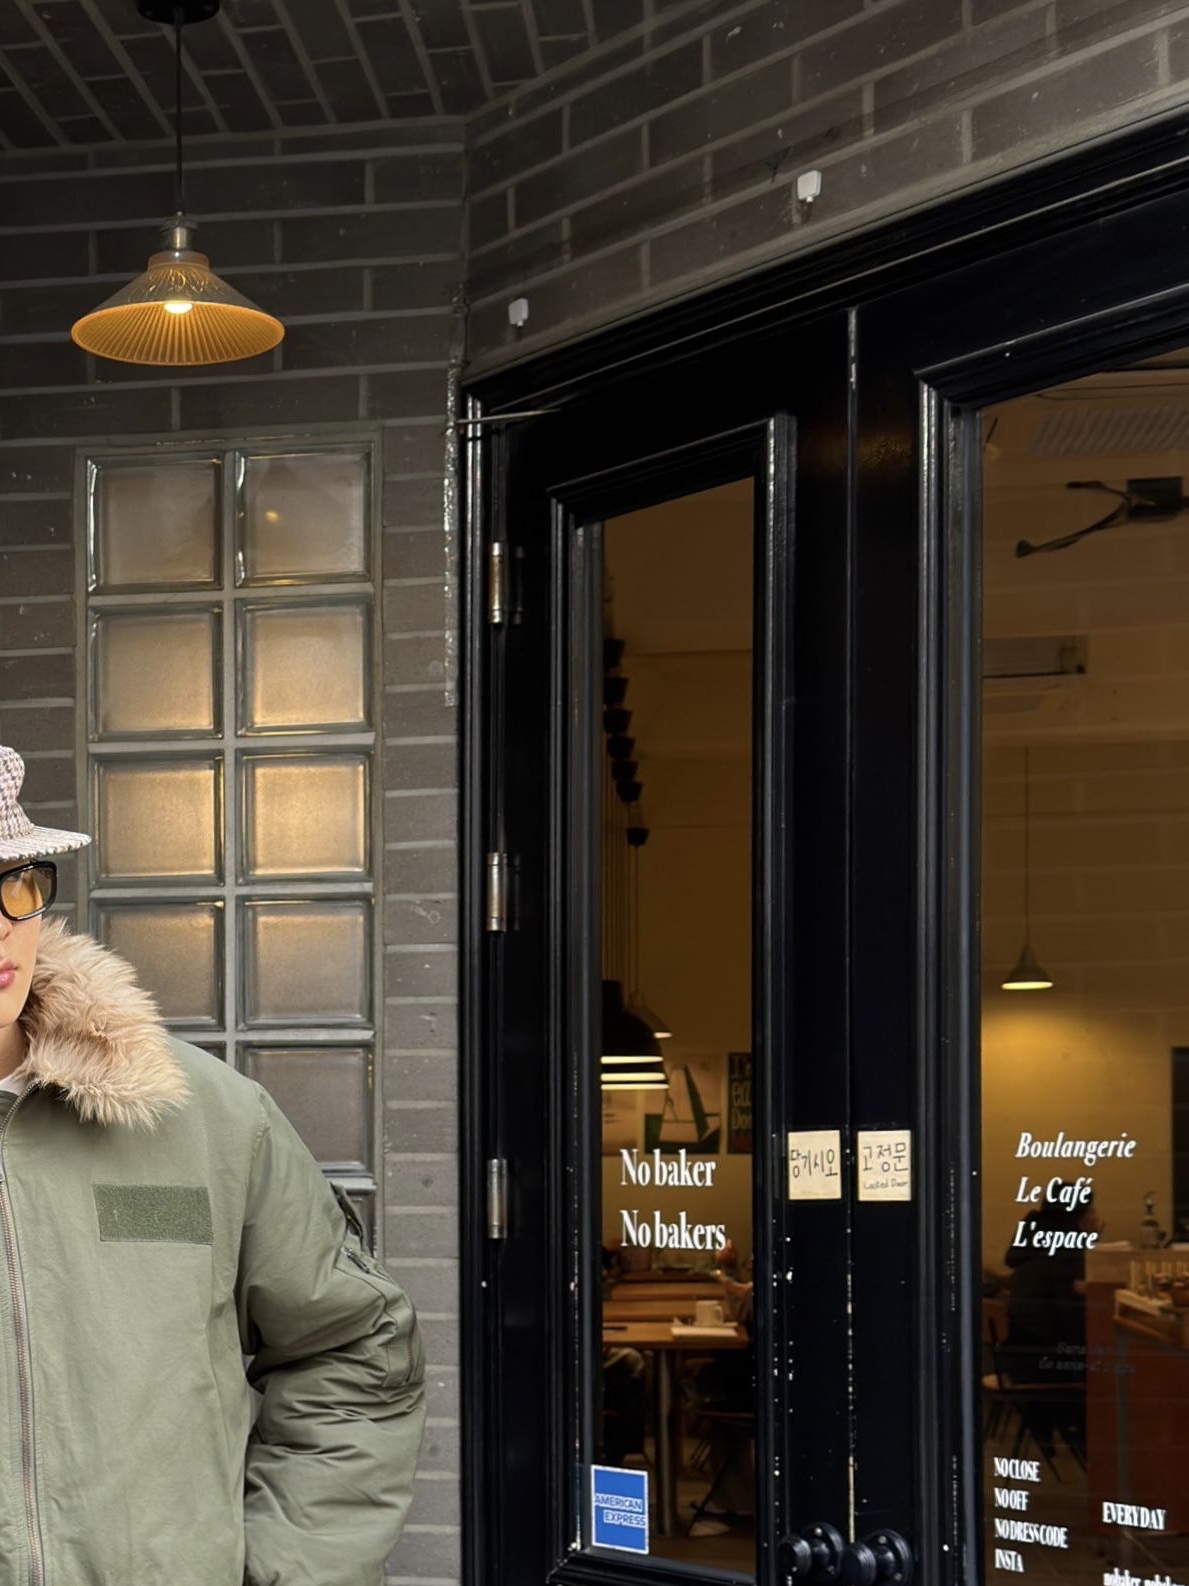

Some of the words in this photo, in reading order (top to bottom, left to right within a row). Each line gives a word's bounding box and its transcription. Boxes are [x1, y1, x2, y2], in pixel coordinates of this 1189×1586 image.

[790, 1148, 839, 1179] 당기시오
[862, 1142, 909, 1172] 고정문
[1015, 1131, 1137, 1167] Boulangerie
[620, 1148, 652, 1187] No
[653, 1148, 717, 1187] baker
[1015, 1176, 1042, 1203] Le
[1046, 1176, 1094, 1212] Café
[620, 1209, 652, 1248] No
[653, 1211, 727, 1251] bakers
[1012, 1220, 1099, 1257] L'espace
[993, 1456, 1009, 1478] NO
[1009, 1458, 1042, 1483] CLOSE
[594, 1494, 644, 1511] AMERICAN
[994, 1487, 1009, 1509] NO
[1009, 1489, 1030, 1512] OFF
[604, 1511, 646, 1527] EXPRESS
[994, 1517, 1010, 1539] NO
[1009, 1519, 1040, 1544] DRESS
[1039, 1524, 1069, 1549] CODE
[994, 1548, 1025, 1573] INSTA
